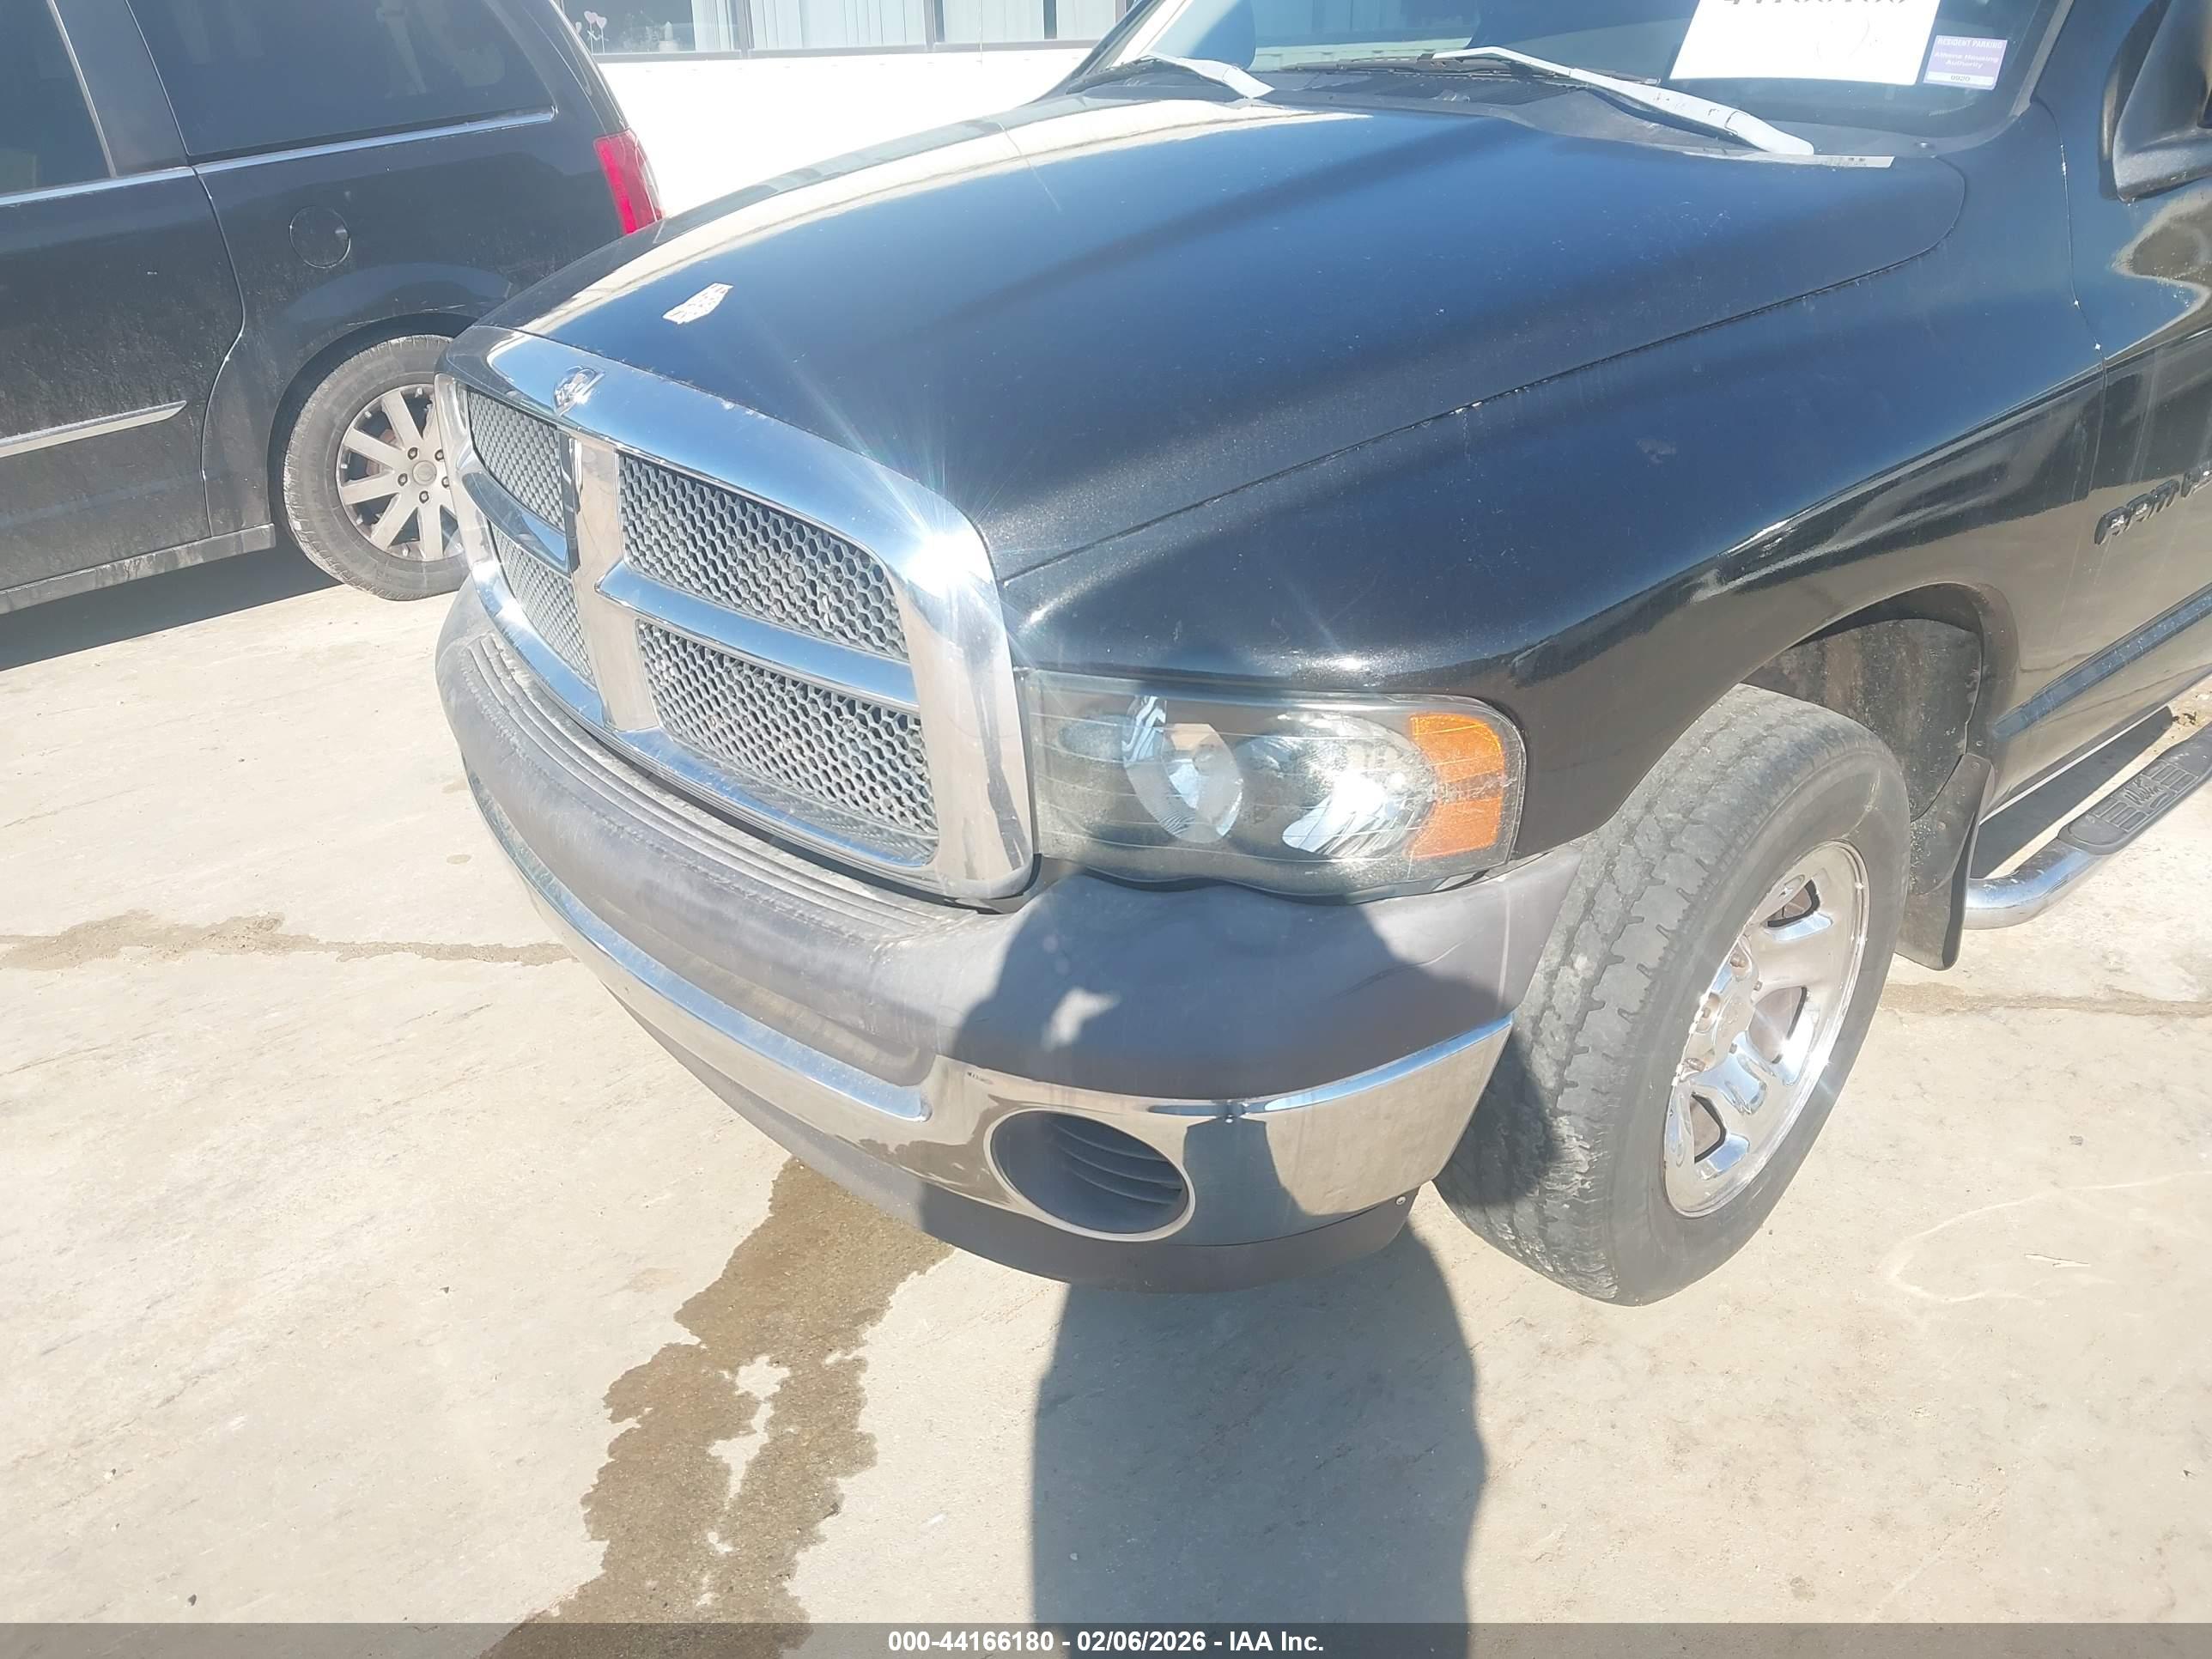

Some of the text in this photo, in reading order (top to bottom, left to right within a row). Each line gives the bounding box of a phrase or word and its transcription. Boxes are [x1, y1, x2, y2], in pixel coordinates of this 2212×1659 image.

[1937, 38, 2003, 49] RESIDENT PARKING
[1964, 54, 2001, 64] Housing
[1945, 60, 1984, 70] Authority
